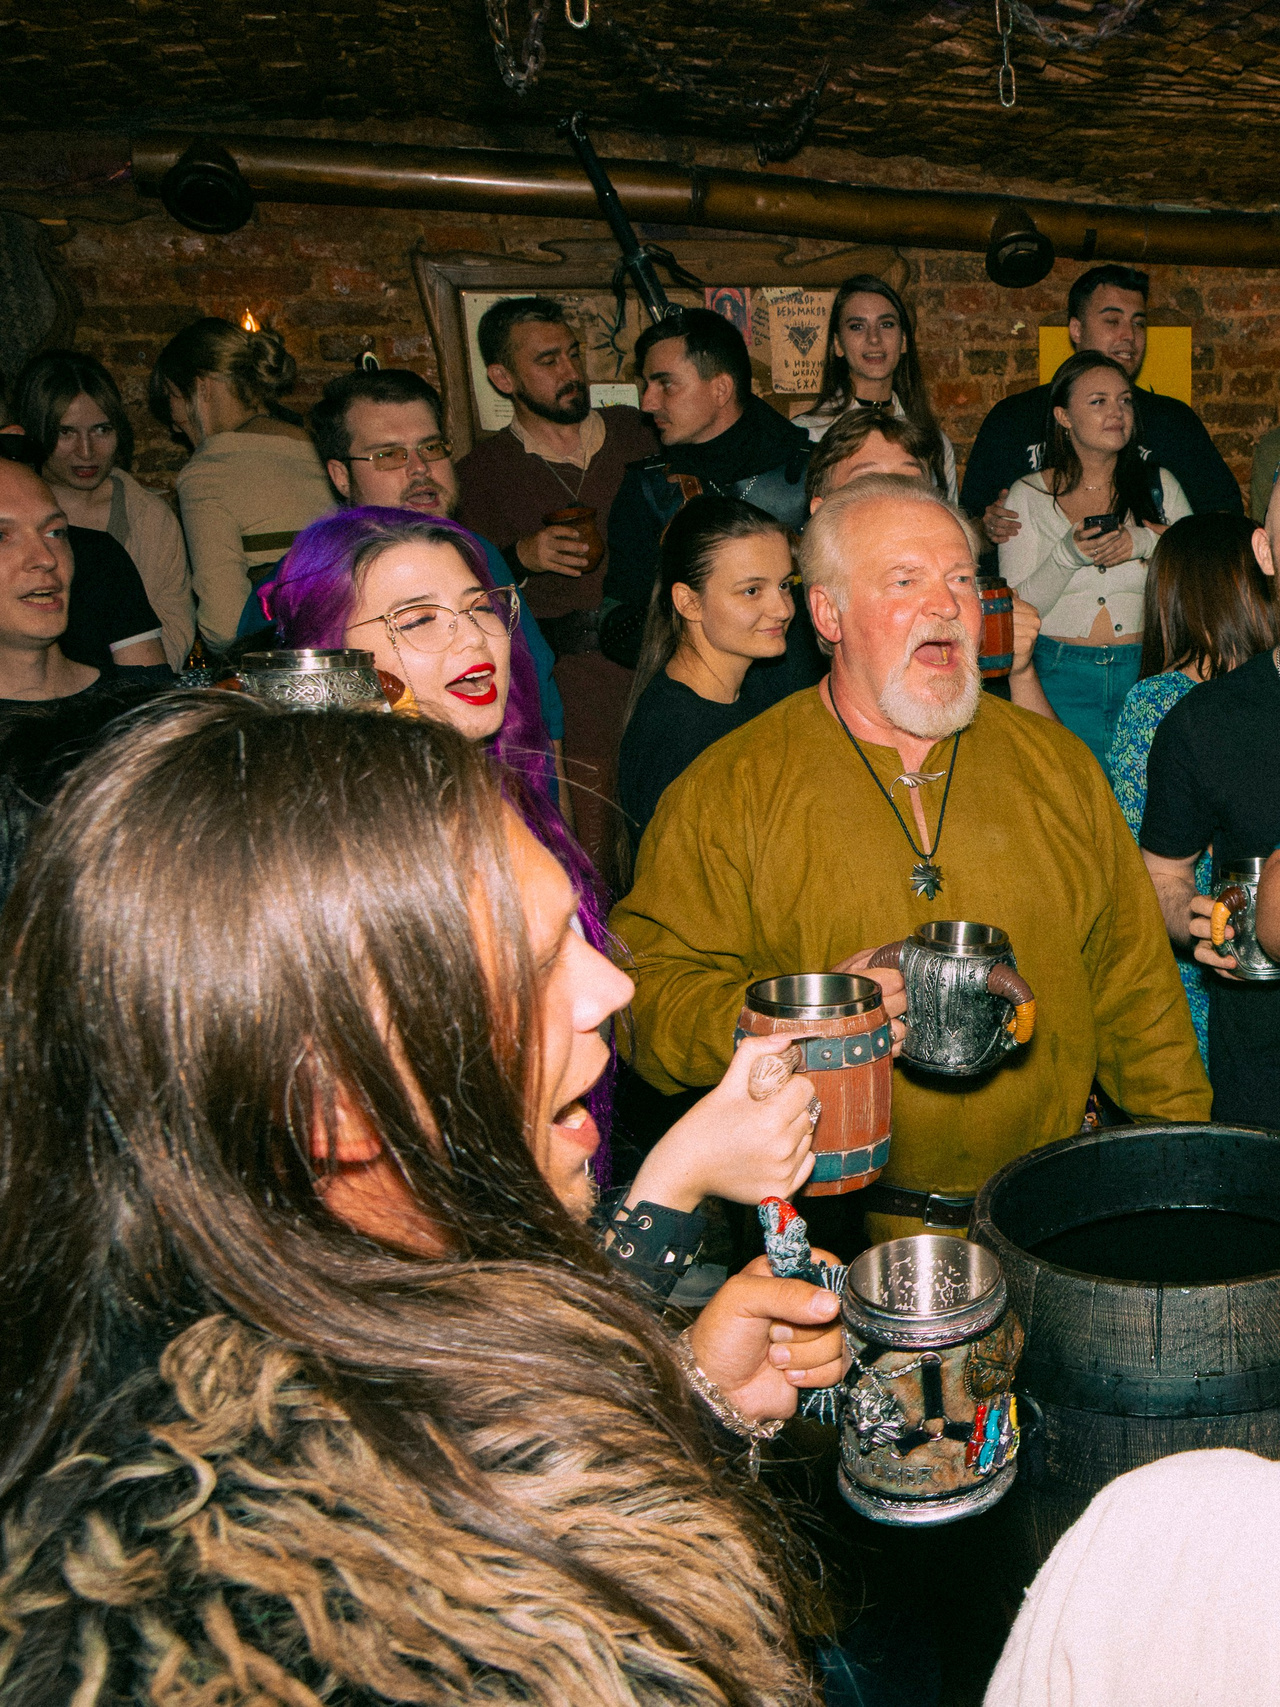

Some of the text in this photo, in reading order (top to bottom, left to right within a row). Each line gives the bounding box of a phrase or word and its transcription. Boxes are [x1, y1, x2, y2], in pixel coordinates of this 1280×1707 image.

[777, 306, 826, 318] ВЕДЬМАКОВ
[792, 370, 820, 378] ШКОЛУ
[797, 379, 818, 390] ЕЖА
